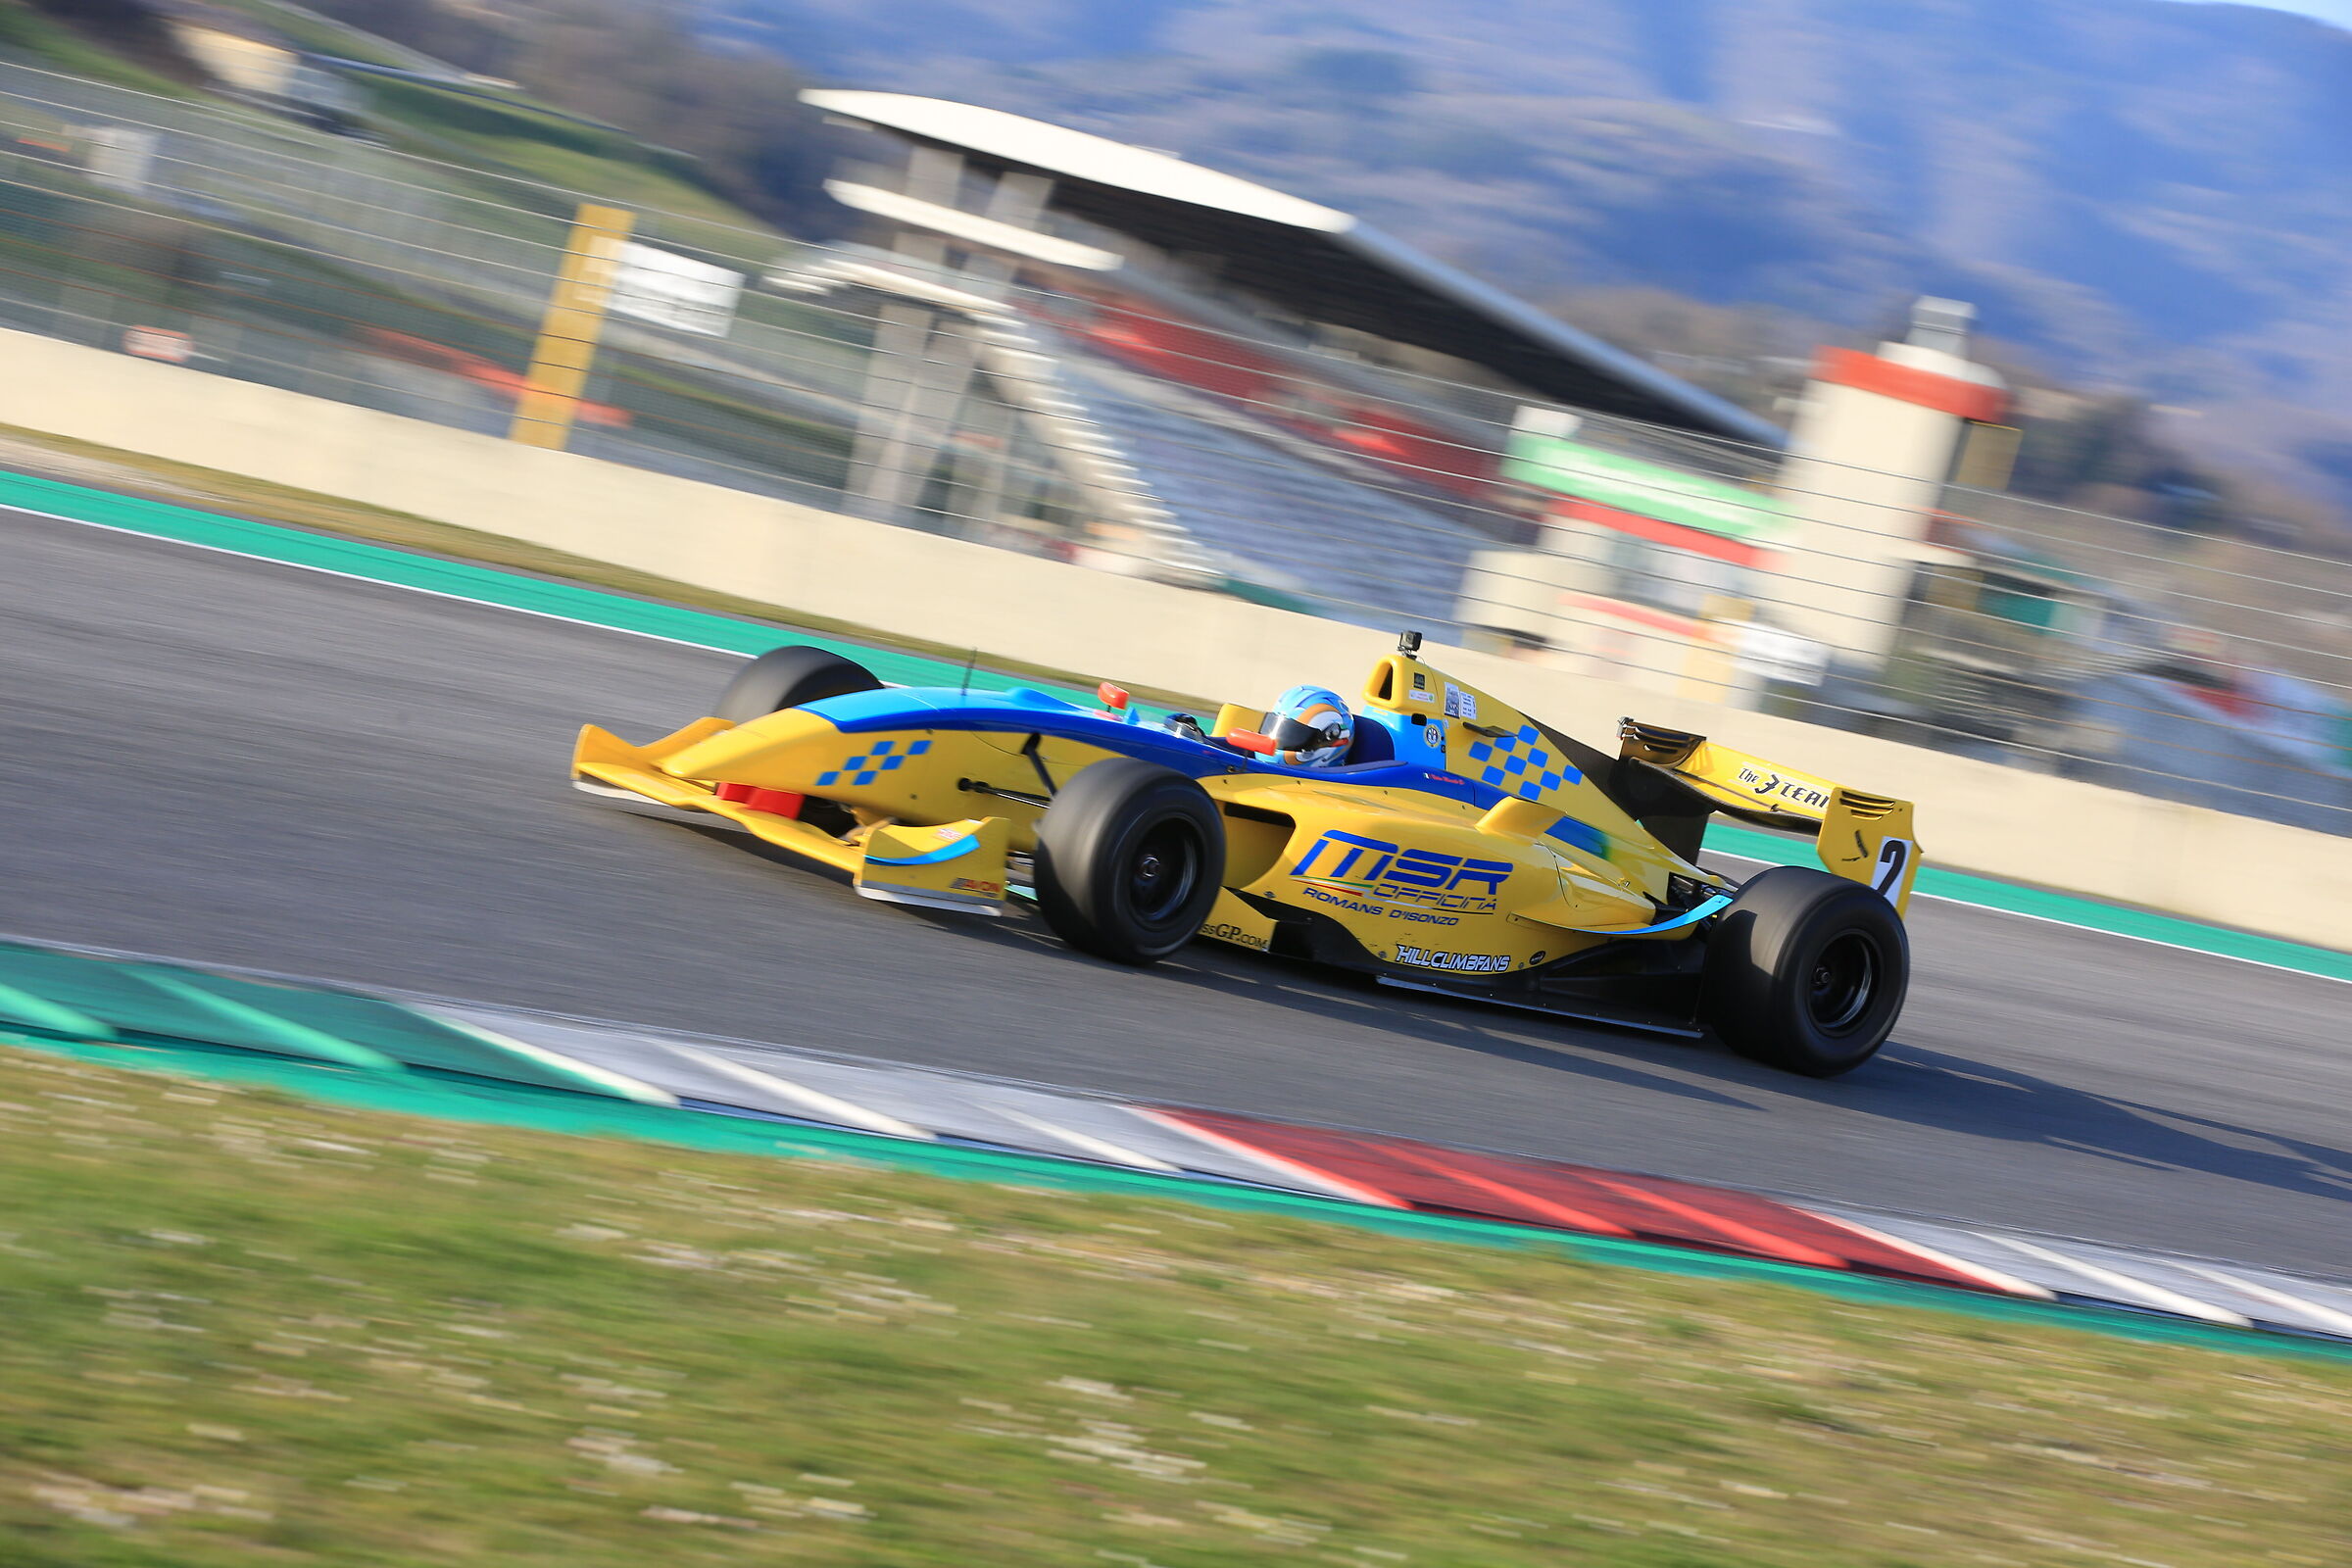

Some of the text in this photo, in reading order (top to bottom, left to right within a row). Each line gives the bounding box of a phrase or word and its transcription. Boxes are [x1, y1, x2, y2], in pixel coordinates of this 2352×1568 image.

[1738, 767, 1760, 784] The
[1290, 829, 1514, 896] MSR
[1877, 839, 1906, 896] 2
[1302, 887, 1460, 926] ROMANS D'ISONZO
[1372, 883, 1497, 910] OFFICINA
[1396, 943, 1511, 972] HILLCLIMBFANS
